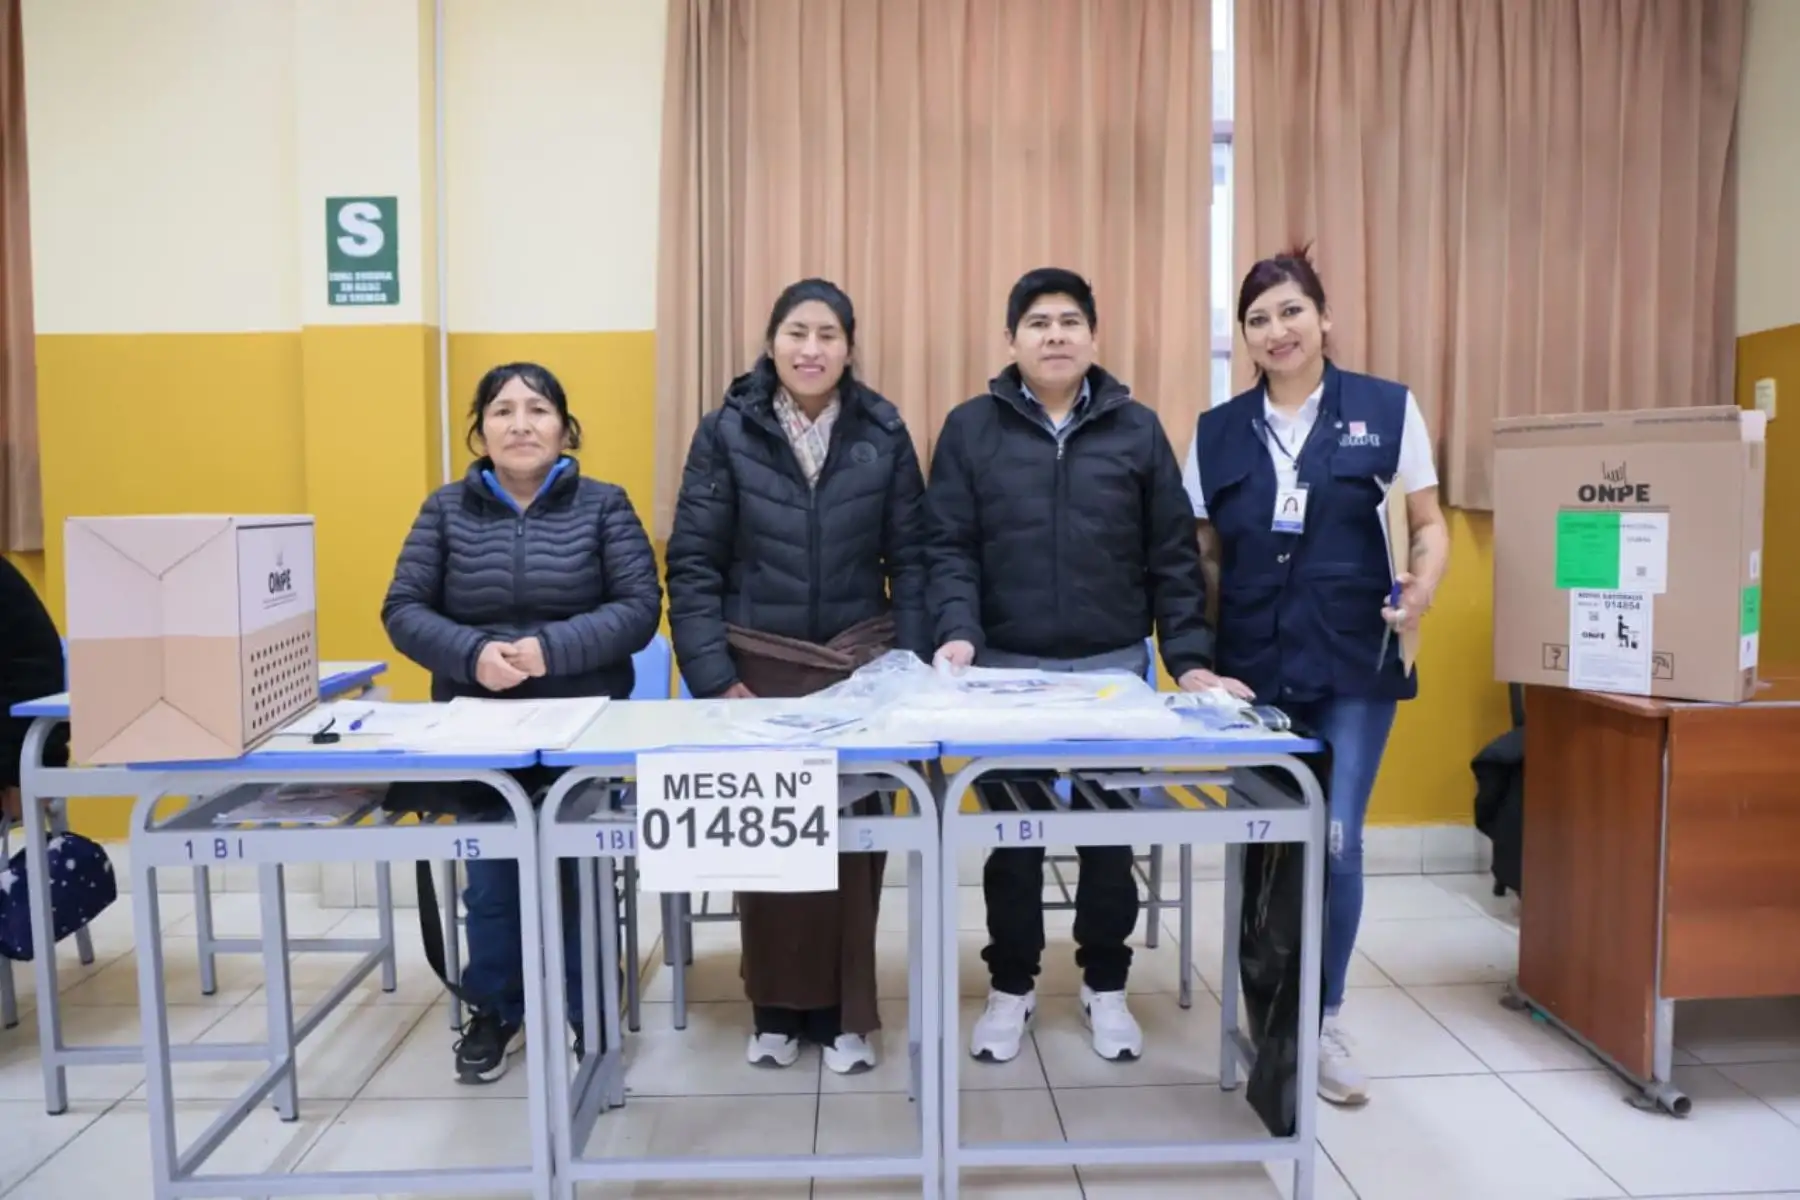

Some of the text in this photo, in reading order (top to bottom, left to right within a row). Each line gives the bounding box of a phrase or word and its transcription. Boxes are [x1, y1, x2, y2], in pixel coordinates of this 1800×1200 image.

[337, 201, 384, 258] S
[1578, 484, 1651, 503] ONPE
[664, 772, 764, 800] MESA
[642, 805, 830, 850] 014854
[1246, 820, 1271, 840] 17
[453, 838, 481, 858] 15
